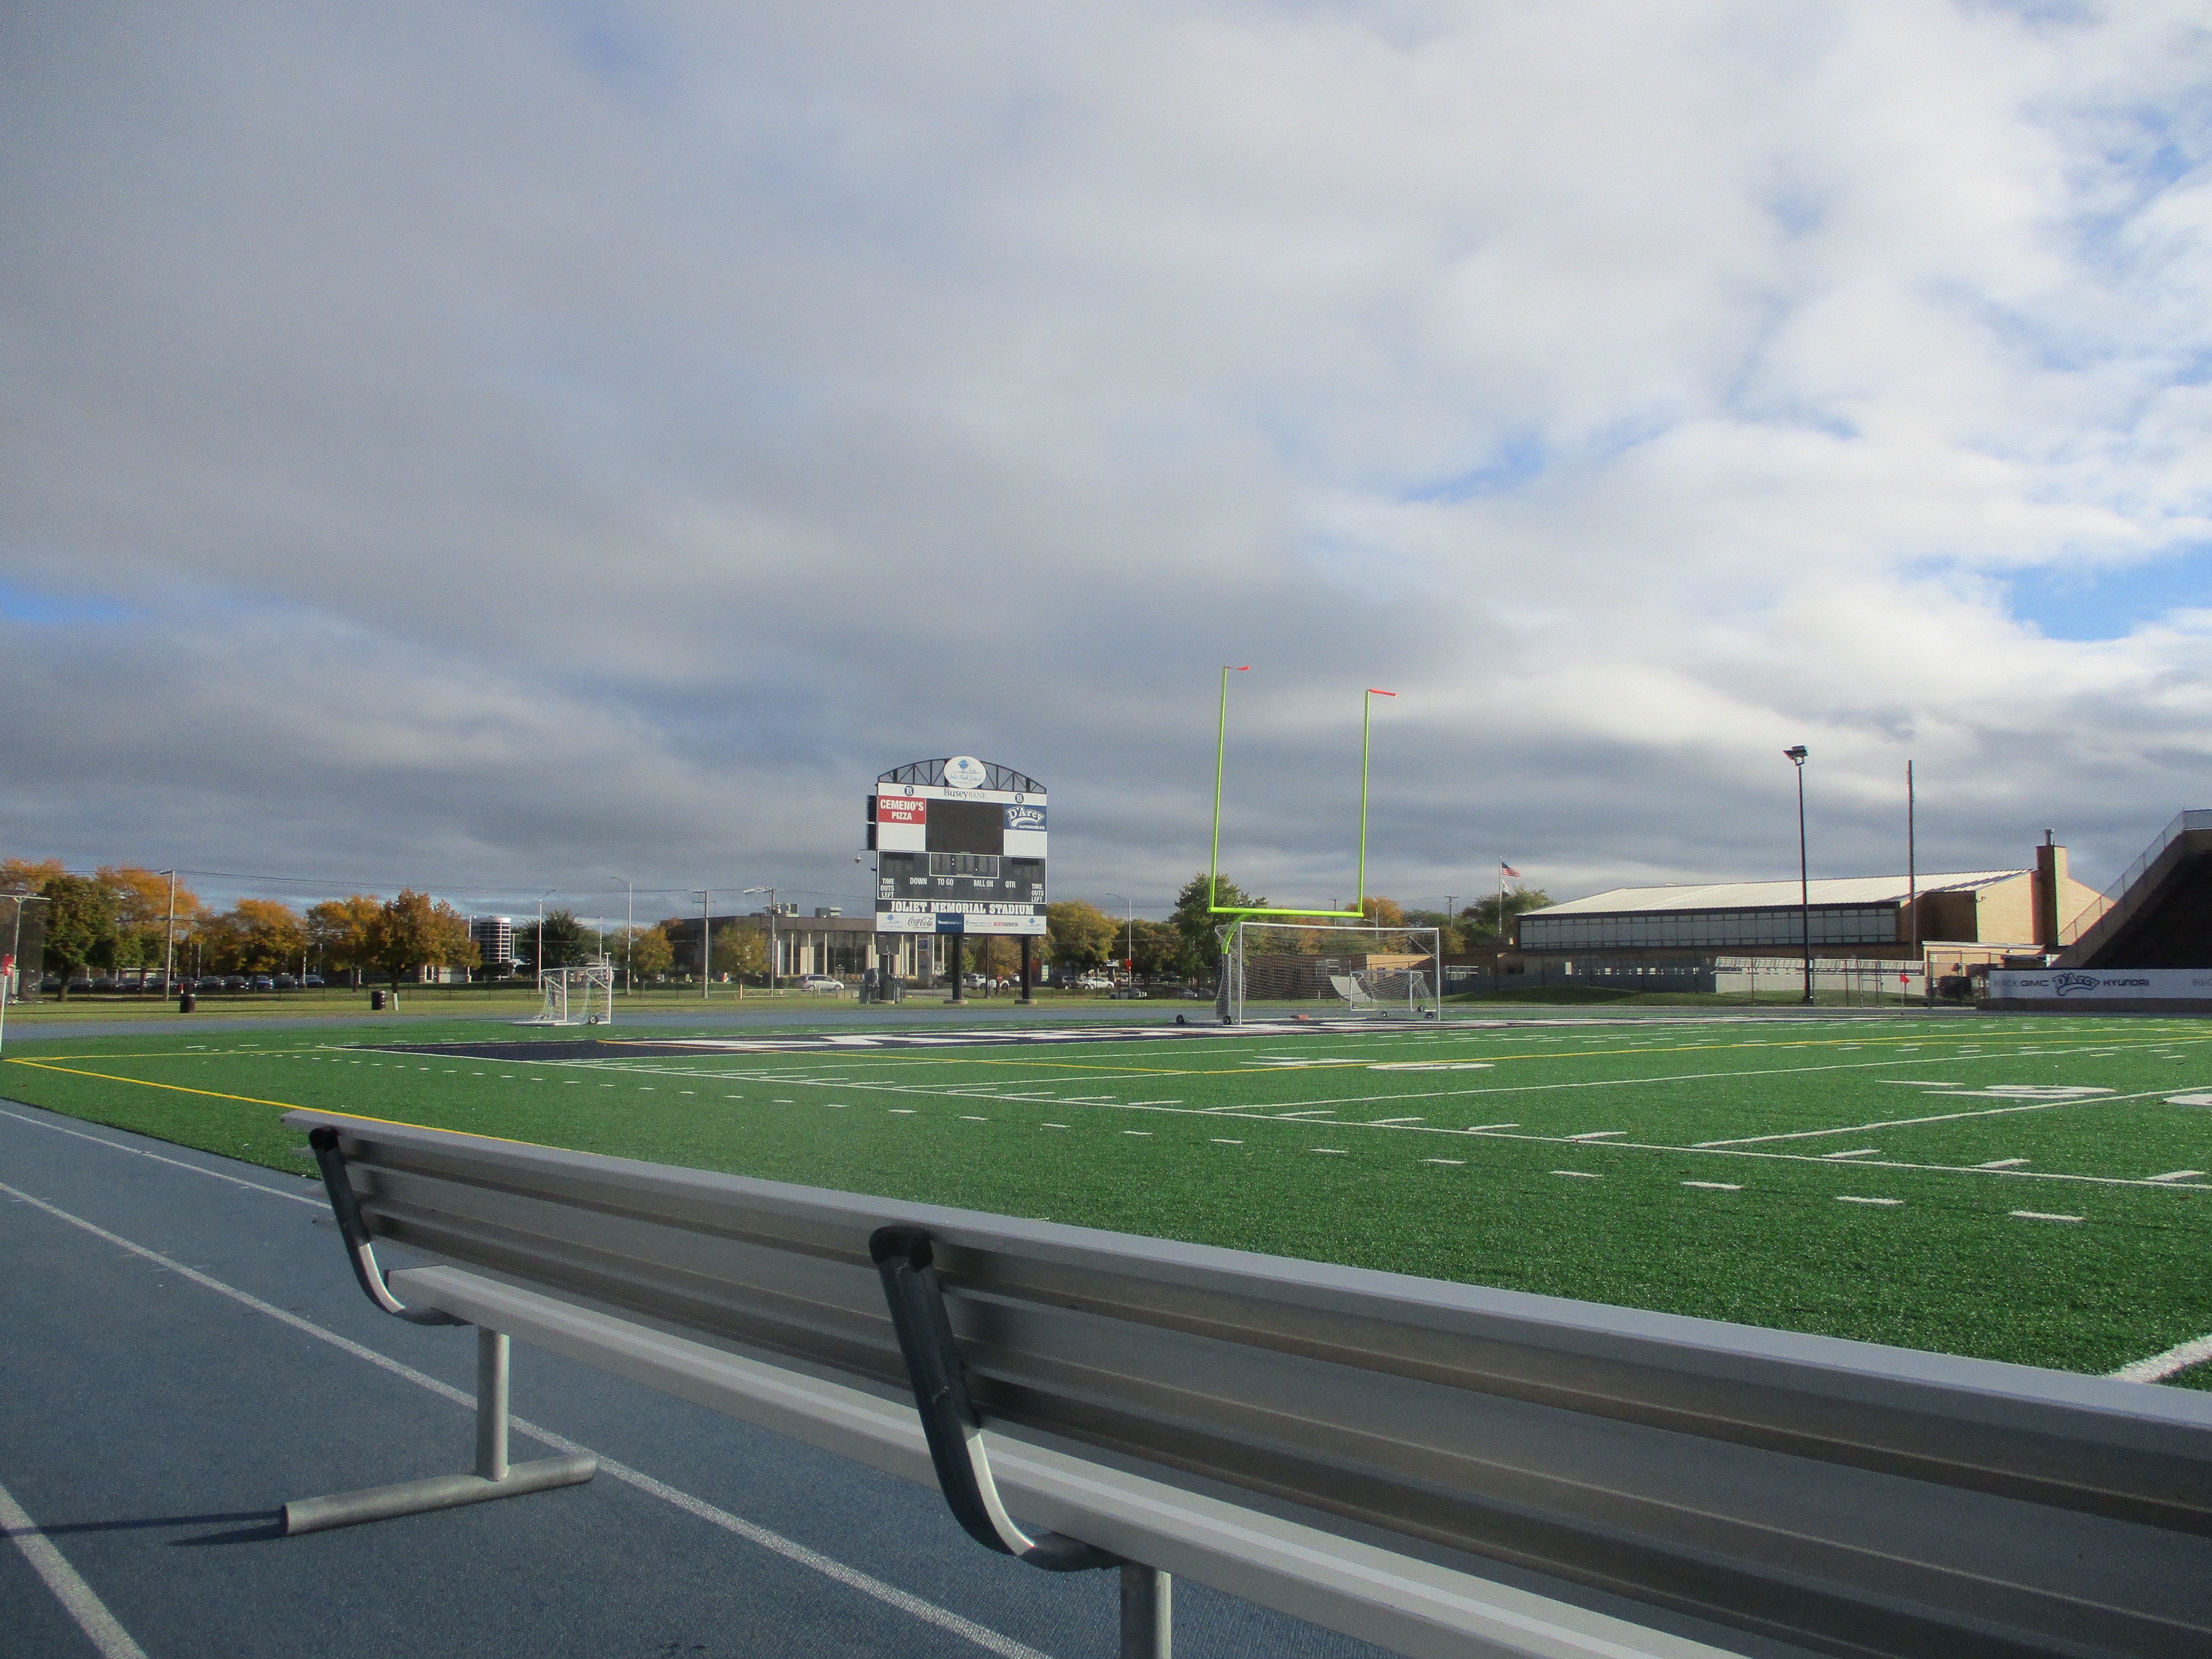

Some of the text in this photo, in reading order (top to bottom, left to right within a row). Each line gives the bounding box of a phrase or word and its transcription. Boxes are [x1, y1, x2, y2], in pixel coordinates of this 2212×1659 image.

[880, 799, 924, 811] CEMENO'S
[891, 811, 912, 820] PIZZA
[1006, 806, 1045, 823] D'Arcy
[891, 901, 1034, 915] JOLIET MEMORIAL STADIUM
